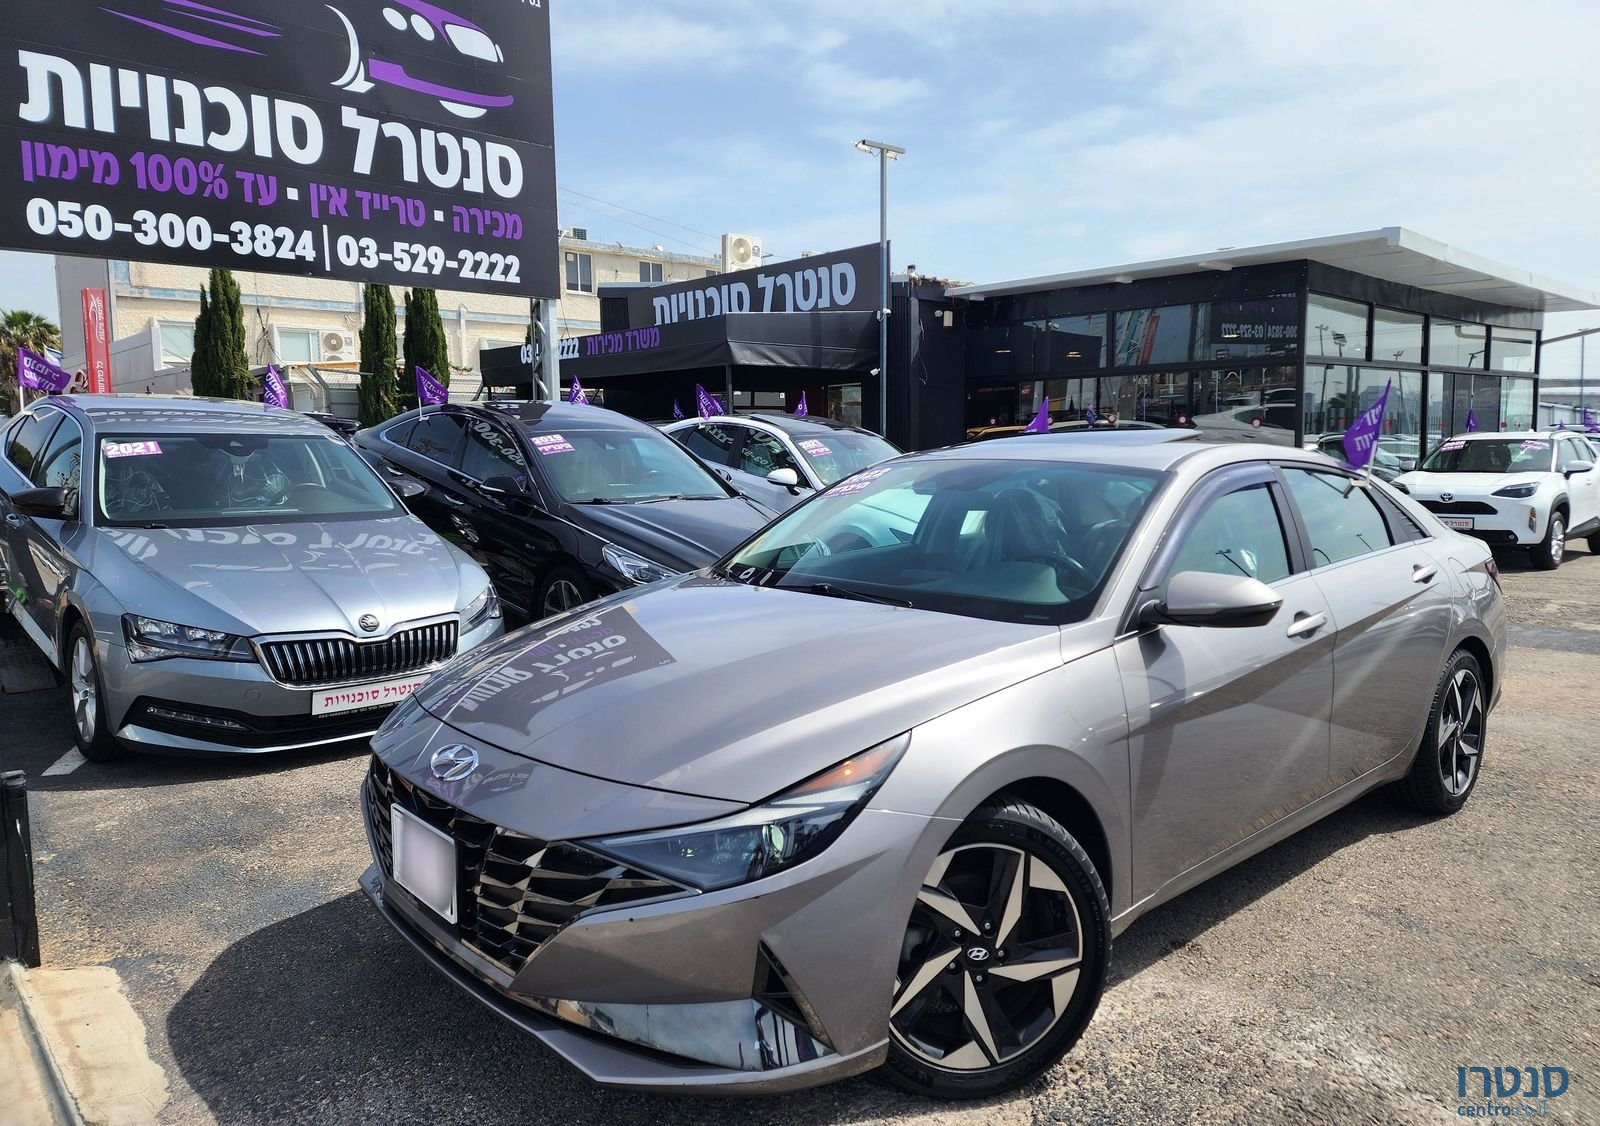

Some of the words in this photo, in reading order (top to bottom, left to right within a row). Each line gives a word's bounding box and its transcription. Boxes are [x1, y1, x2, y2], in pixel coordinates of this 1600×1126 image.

[19, 50, 323, 164] סוכנויות
[20, 140, 120, 186] מימון
[341, 105, 523, 198] סנטרל
[129, 151, 229, 200] 100%
[235, 171, 278, 206] עד
[309, 182, 349, 219] אין
[355, 190, 426, 228] טרייד
[26, 197, 316, 262] 050-300-3824
[336, 235, 521, 283] 03-529-2222
[452, 205, 523, 240] מכירה
[652, 281, 750, 326] סוכנויות
[757, 262, 856, 312] סנטרל
[586, 333, 624, 356] מכירות
[625, 327, 660, 350] משרד
[105, 441, 158, 455] 2021
[324, 690, 379, 707] סוכנויות
